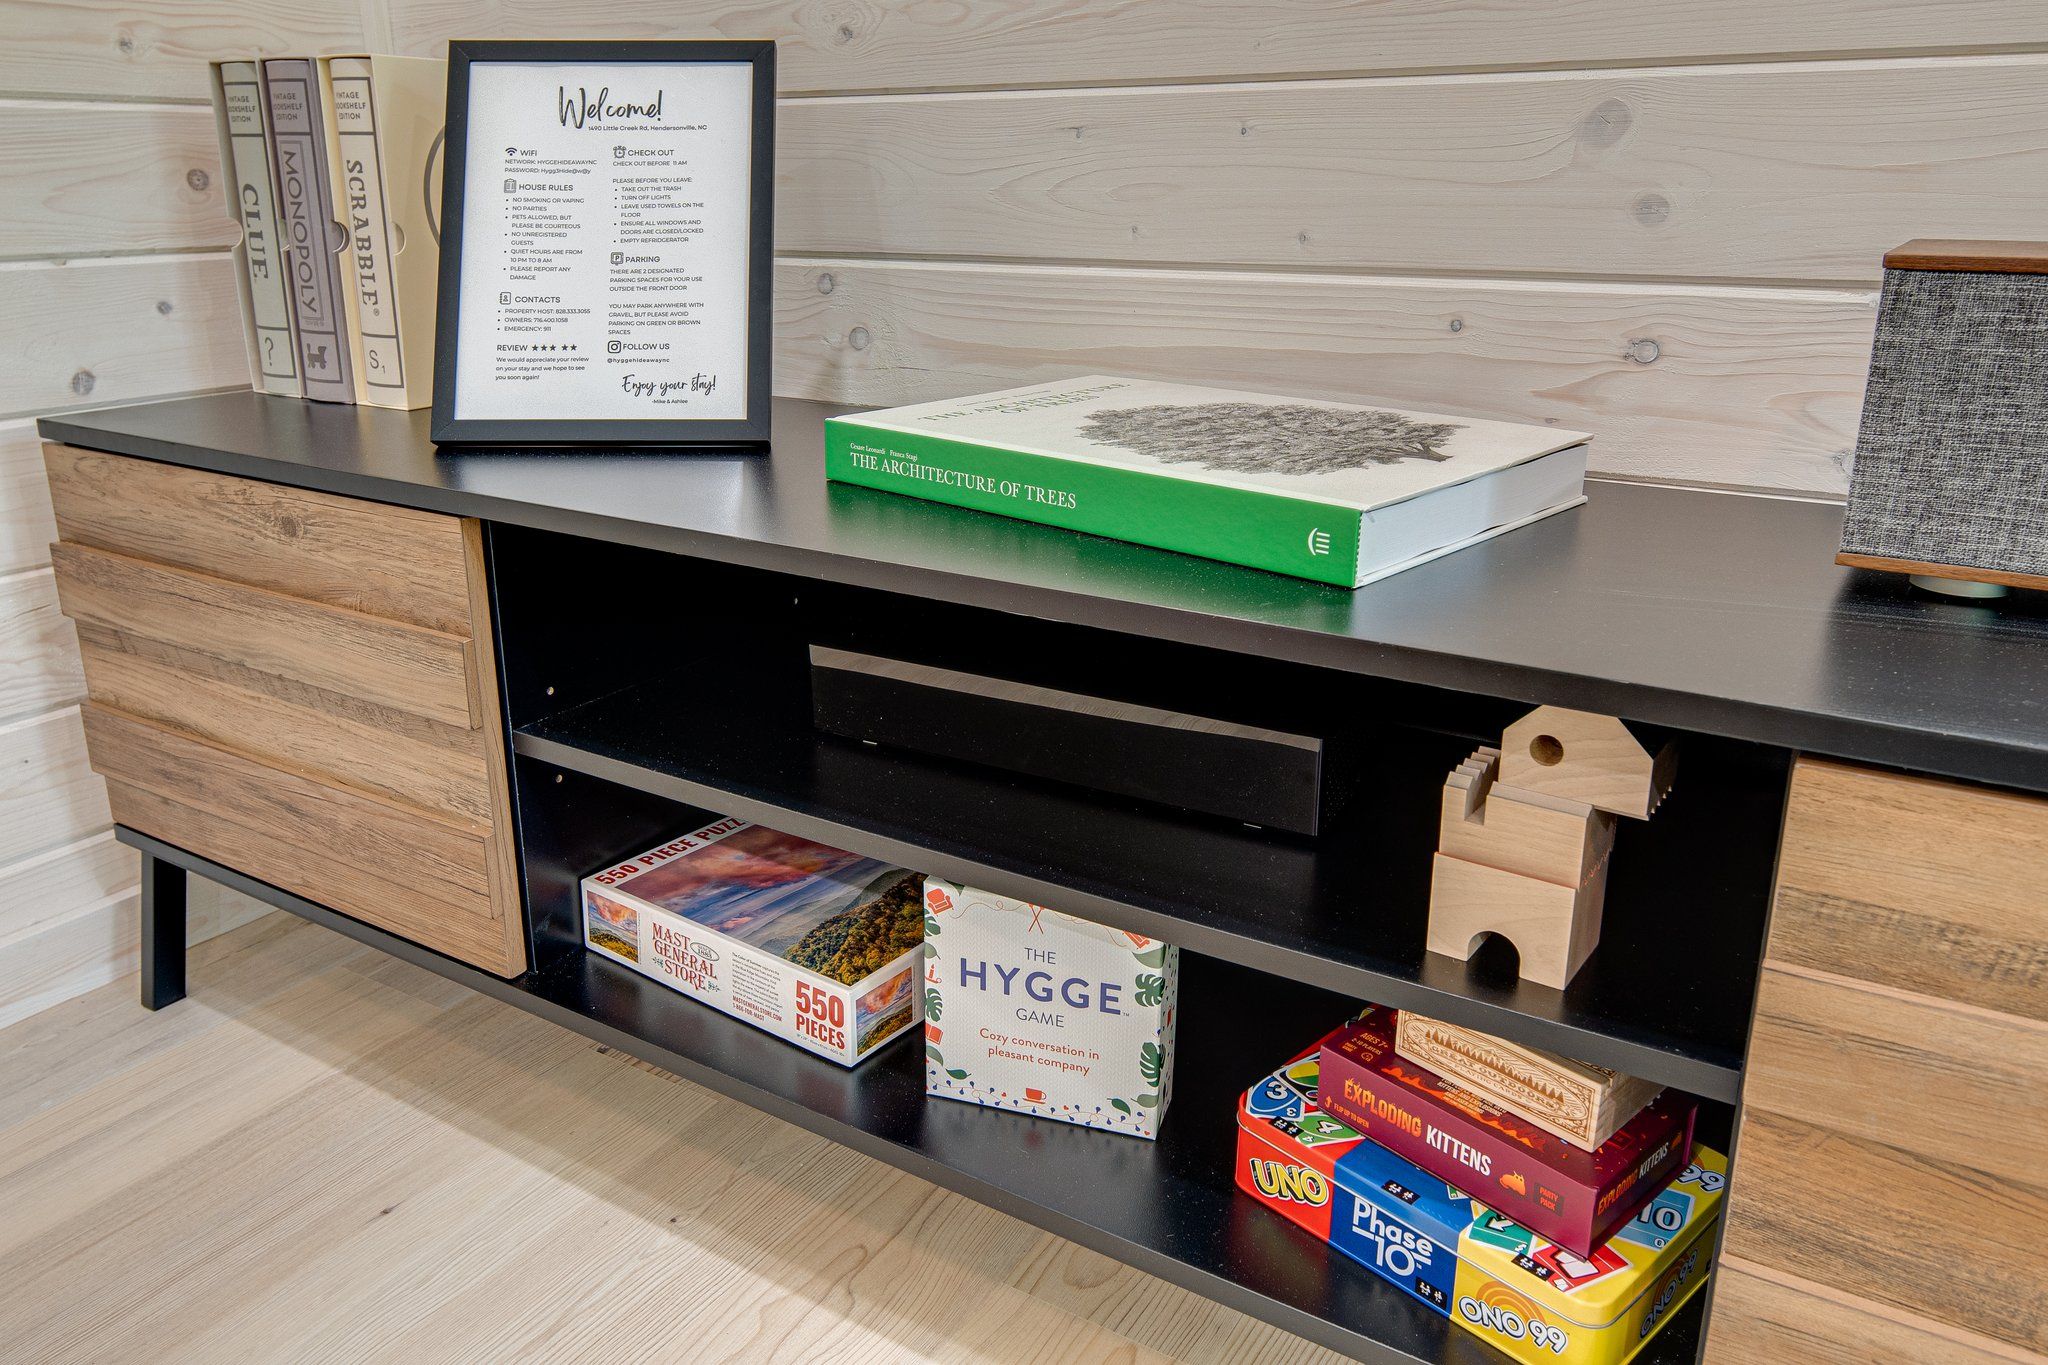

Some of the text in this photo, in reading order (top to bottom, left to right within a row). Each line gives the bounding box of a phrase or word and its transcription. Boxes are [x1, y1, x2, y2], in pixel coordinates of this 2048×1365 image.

[559, 86, 662, 129] Welcome!
[242, 183, 269, 279] CLUE
[282, 150, 317, 314] MONOPOLY
[622, 373, 716, 397] Enjoy your stay!
[850, 452, 1076, 509] THE ARCHITECTURE OF TREES
[594, 818, 746, 884] 550 PIECE PUZZ
[652, 922, 690, 951] MAST
[1025, 947, 1056, 964] THE
[654, 940, 718, 980] GENERAL
[665, 959, 706, 991] STORE
[796, 980, 845, 1028] 550
[1016, 1008, 1064, 1028] GAME
[796, 1013, 845, 1050] PIECES
[980, 1028, 1099, 1060] Cozy conversation in
[1360, 1033, 1380, 1044] AGES
[988, 1046, 1089, 1076] pleasant company
[1265, 1081, 1288, 1101] 3
[1318, 1120, 1343, 1135] 4
[1344, 1077, 1422, 1137] EXPLODING
[1426, 1124, 1492, 1178] KITTENS
[1250, 1158, 1329, 1207] UNO
[1539, 1187, 1559, 1201] PARTY
[1598, 1142, 1669, 1217] EXPLODING KITTENS
[1540, 1198, 1556, 1211] PACK
[1353, 1197, 1433, 1257] Phase
[1373, 1236, 1415, 1277] 10
[1640, 1249, 1697, 1340] ONO 99
[1459, 1296, 1568, 1354] ONO 99
